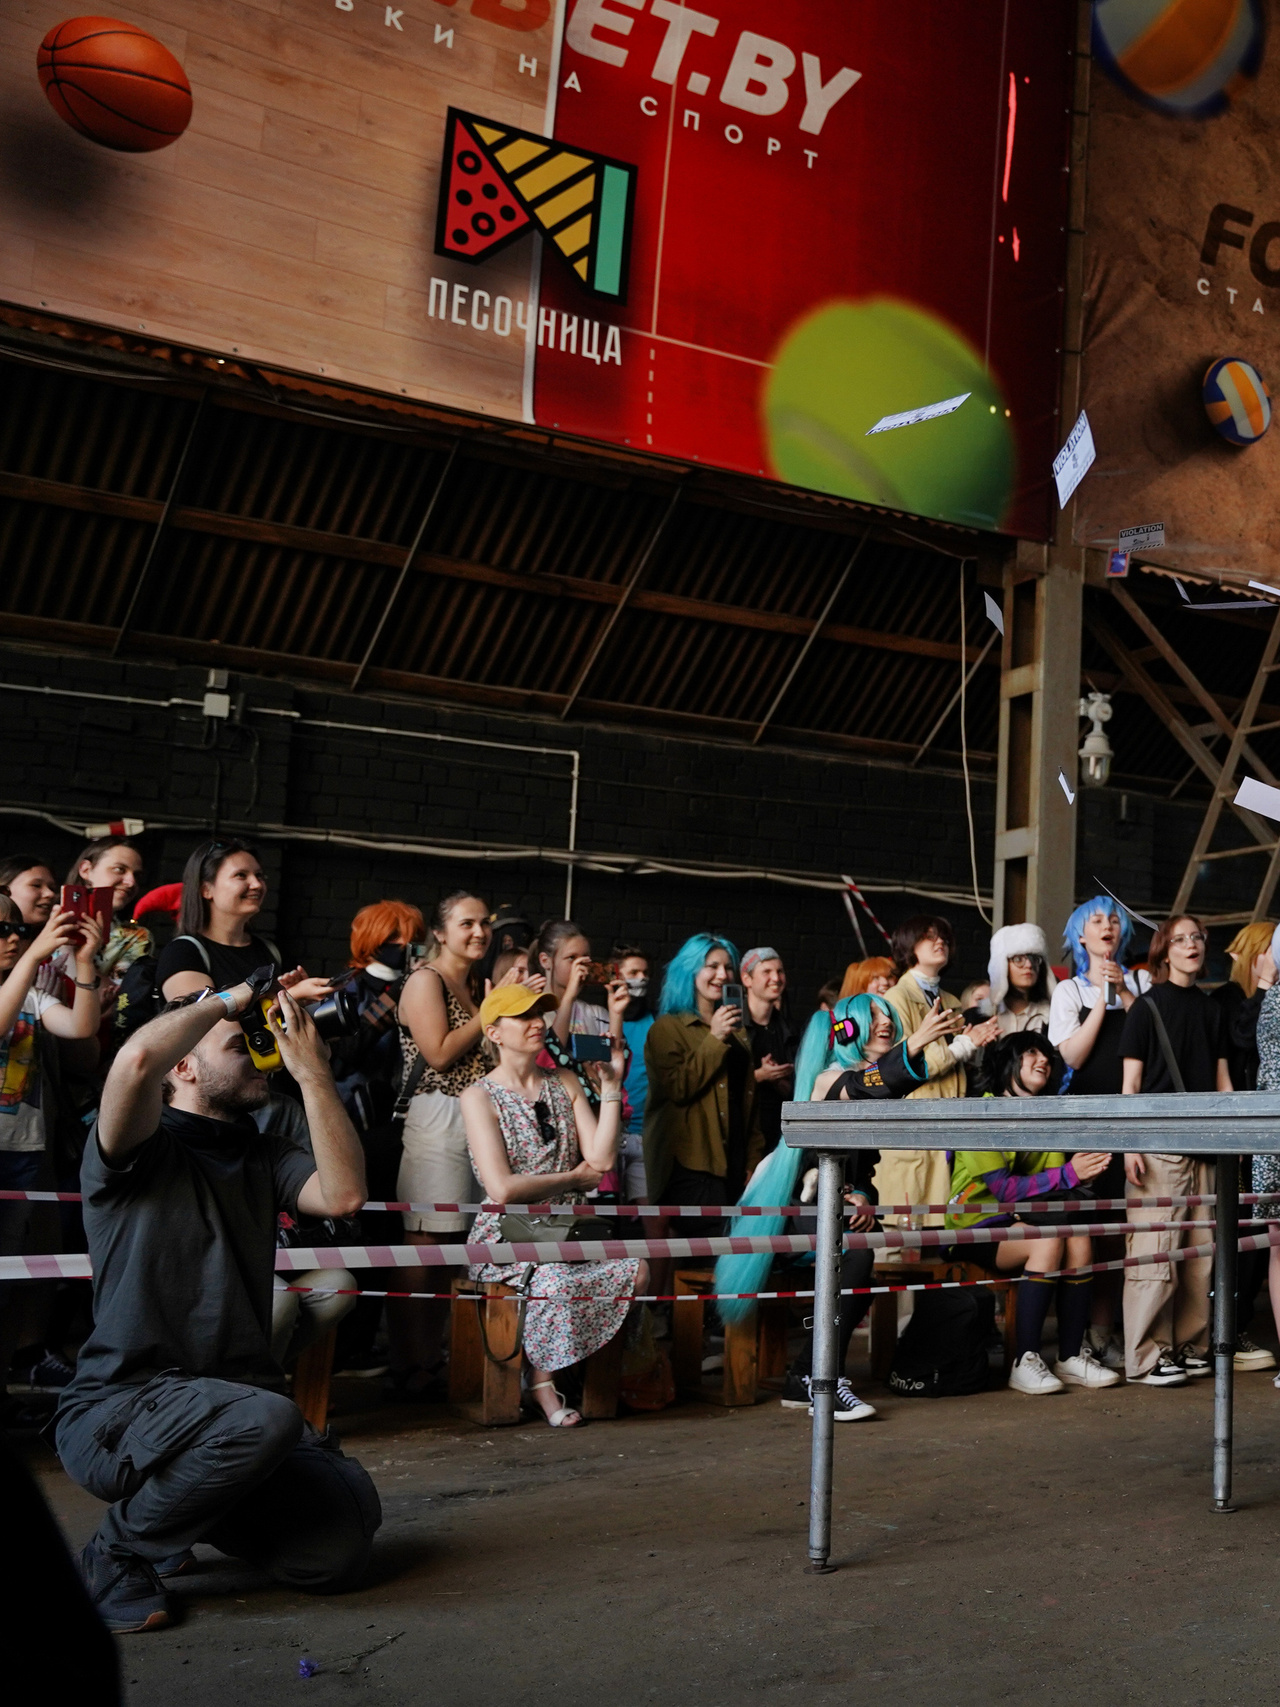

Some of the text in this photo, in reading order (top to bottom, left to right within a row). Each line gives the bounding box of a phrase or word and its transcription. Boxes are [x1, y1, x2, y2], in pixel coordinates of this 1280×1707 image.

[431, 0, 863, 136] ET.BY
[518, 53, 582, 93] НА
[639, 95, 819, 169] СПОРТ
[428, 277, 622, 366] ПЕСОЧНИЦА
[1054, 414, 1087, 475] VIOLATION
[1121, 524, 1164, 537] VIOLATION
